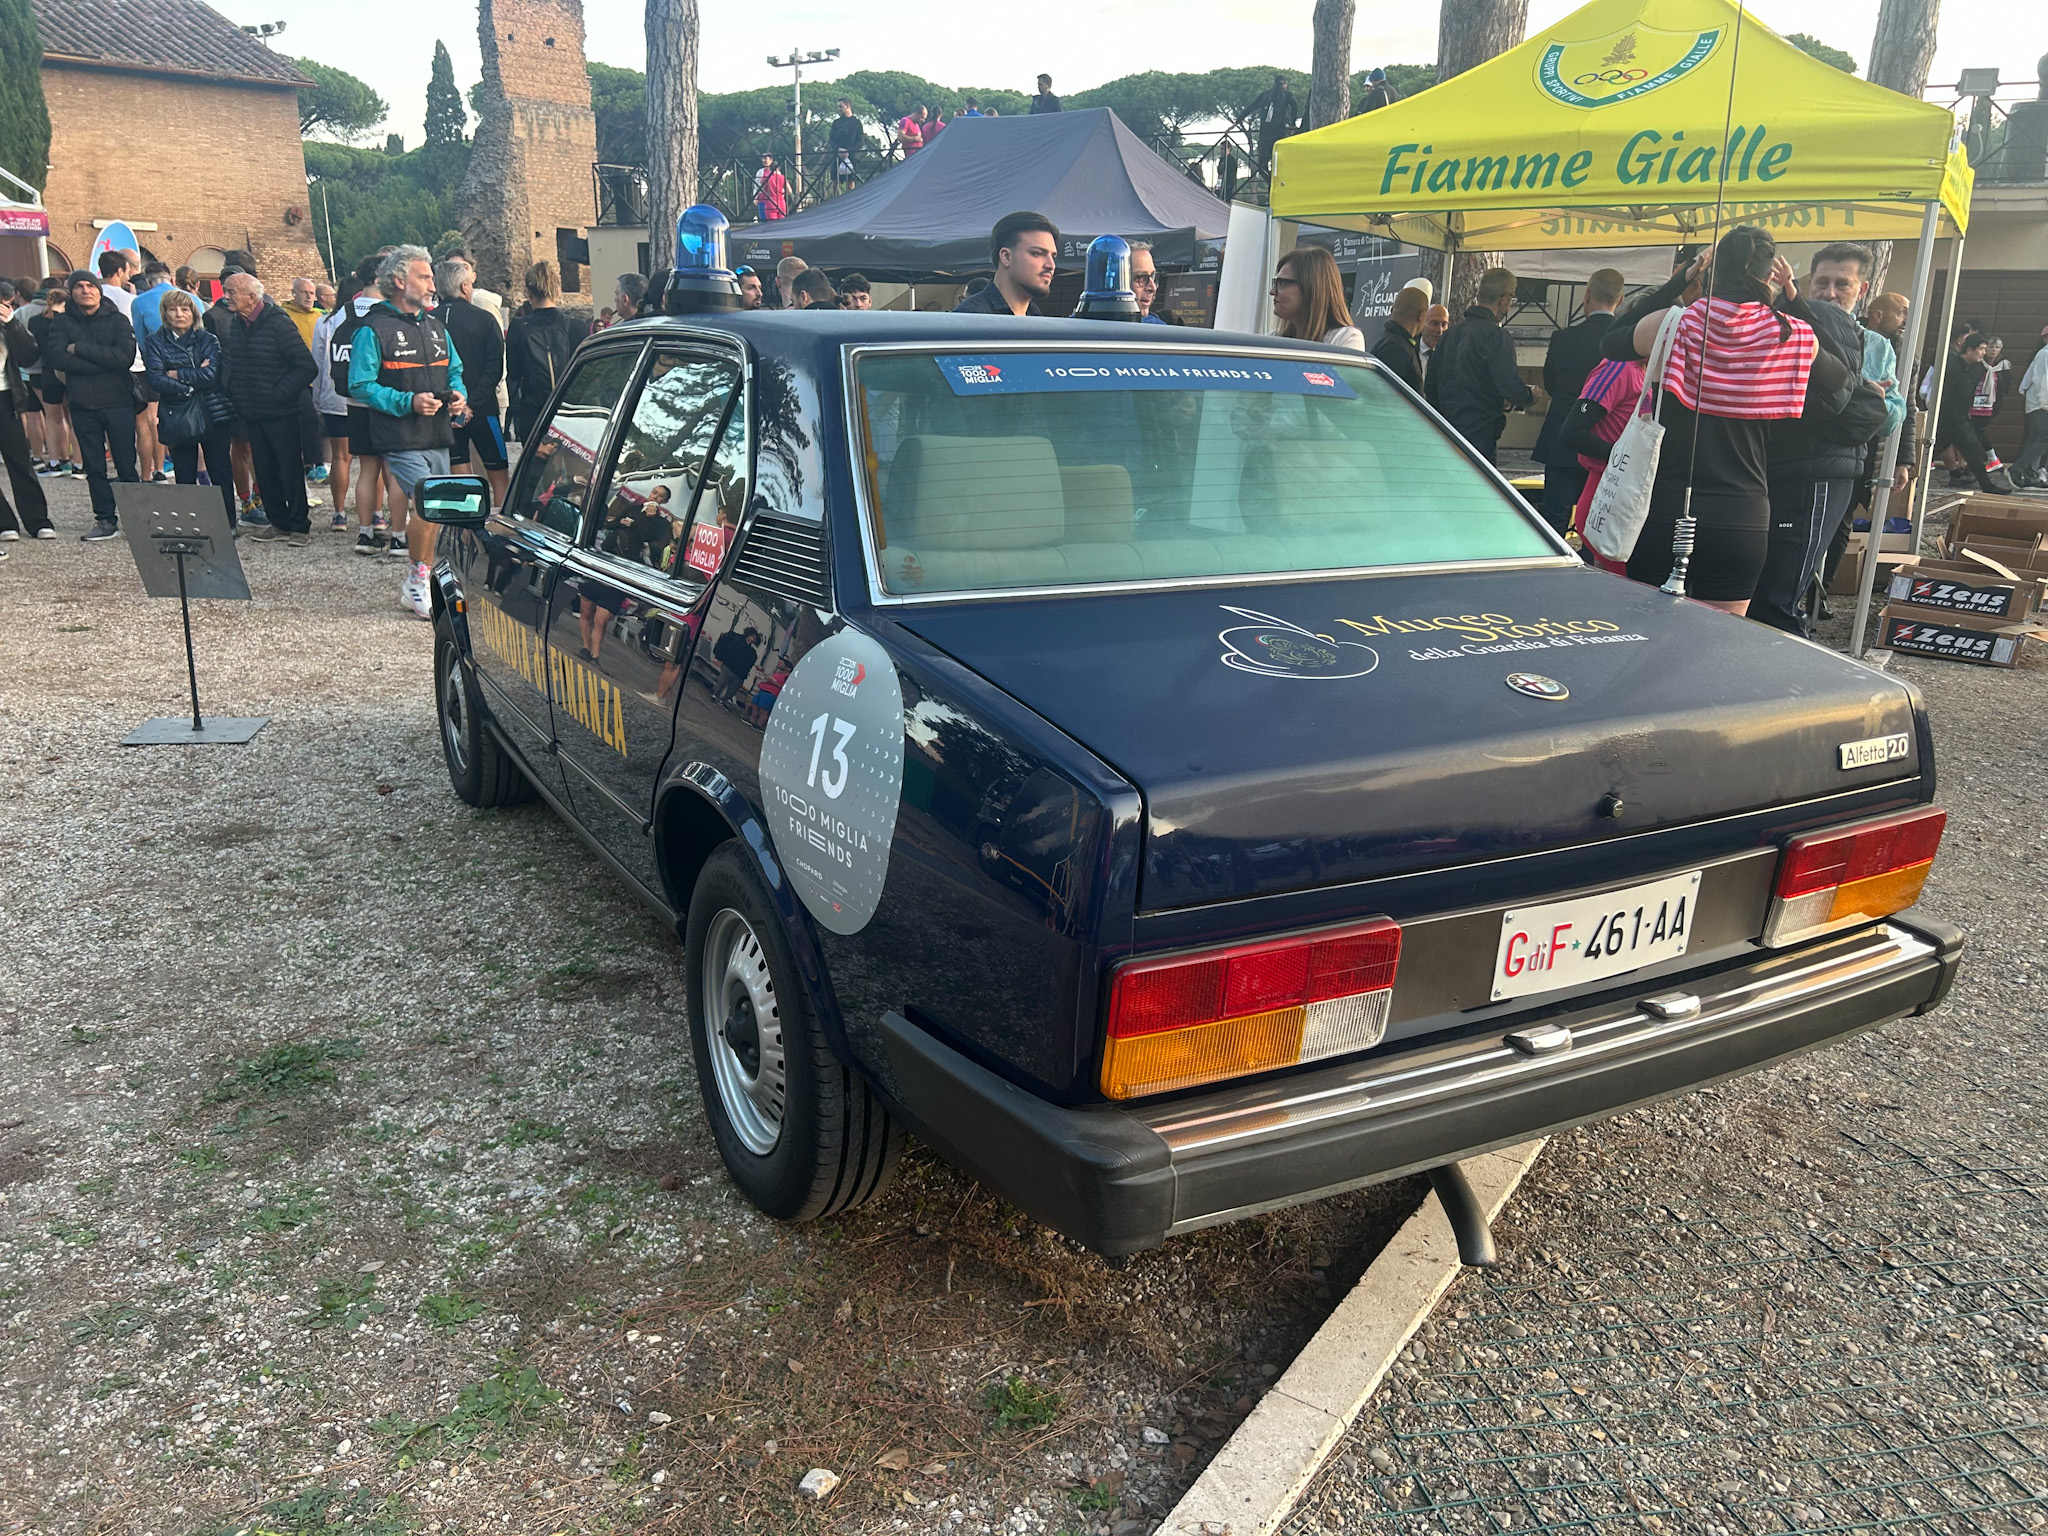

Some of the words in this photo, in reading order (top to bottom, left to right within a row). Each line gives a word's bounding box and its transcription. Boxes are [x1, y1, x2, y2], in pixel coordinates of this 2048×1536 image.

[1544, 52, 1559, 78] GRUPPI
[1617, 72, 1677, 99] FIAMME
[1680, 38, 1712, 68] GIALLE
[1546, 80, 1584, 102] SPORTIVI
[1380, 143, 1593, 195] Fiamme
[1617, 124, 1792, 185] Gialle
[961, 370, 987, 378] 1000
[965, 376, 1003, 384] MIGLIA
[1115, 367, 1180, 377] MIGLIA
[1182, 368, 1251, 379] FRIENDS
[1254, 371, 1273, 380] 13
[698, 528, 718, 548] 1000
[692, 548, 716, 569] MIGLIA
[1911, 597, 1951, 606] veste
[1955, 602, 1976, 610] gli
[1932, 584, 2006, 606] Zeus
[1408, 647, 1465, 661] della
[1460, 639, 1550, 655] Guardia
[1547, 636, 1574, 647] di
[1565, 634, 1649, 645] Finanza
[1893, 640, 1935, 651] veste
[1938, 647, 1959, 655] gli
[1961, 650, 1986, 659] dei
[1914, 628, 1992, 651] Zeus
[480, 597, 532, 684] GUARDIA
[533, 635, 548, 697] di
[550, 646, 628, 758] FINANZA
[835, 665, 855, 682] 1000
[831, 678, 858, 699] MIGLIA
[807, 712, 857, 799] 13
[1845, 745, 1885, 766] Alfetta
[789, 816, 853, 868] FRIENDS
[820, 811, 868, 853] MIGLIA
[796, 858, 823, 880] CHOPARD
